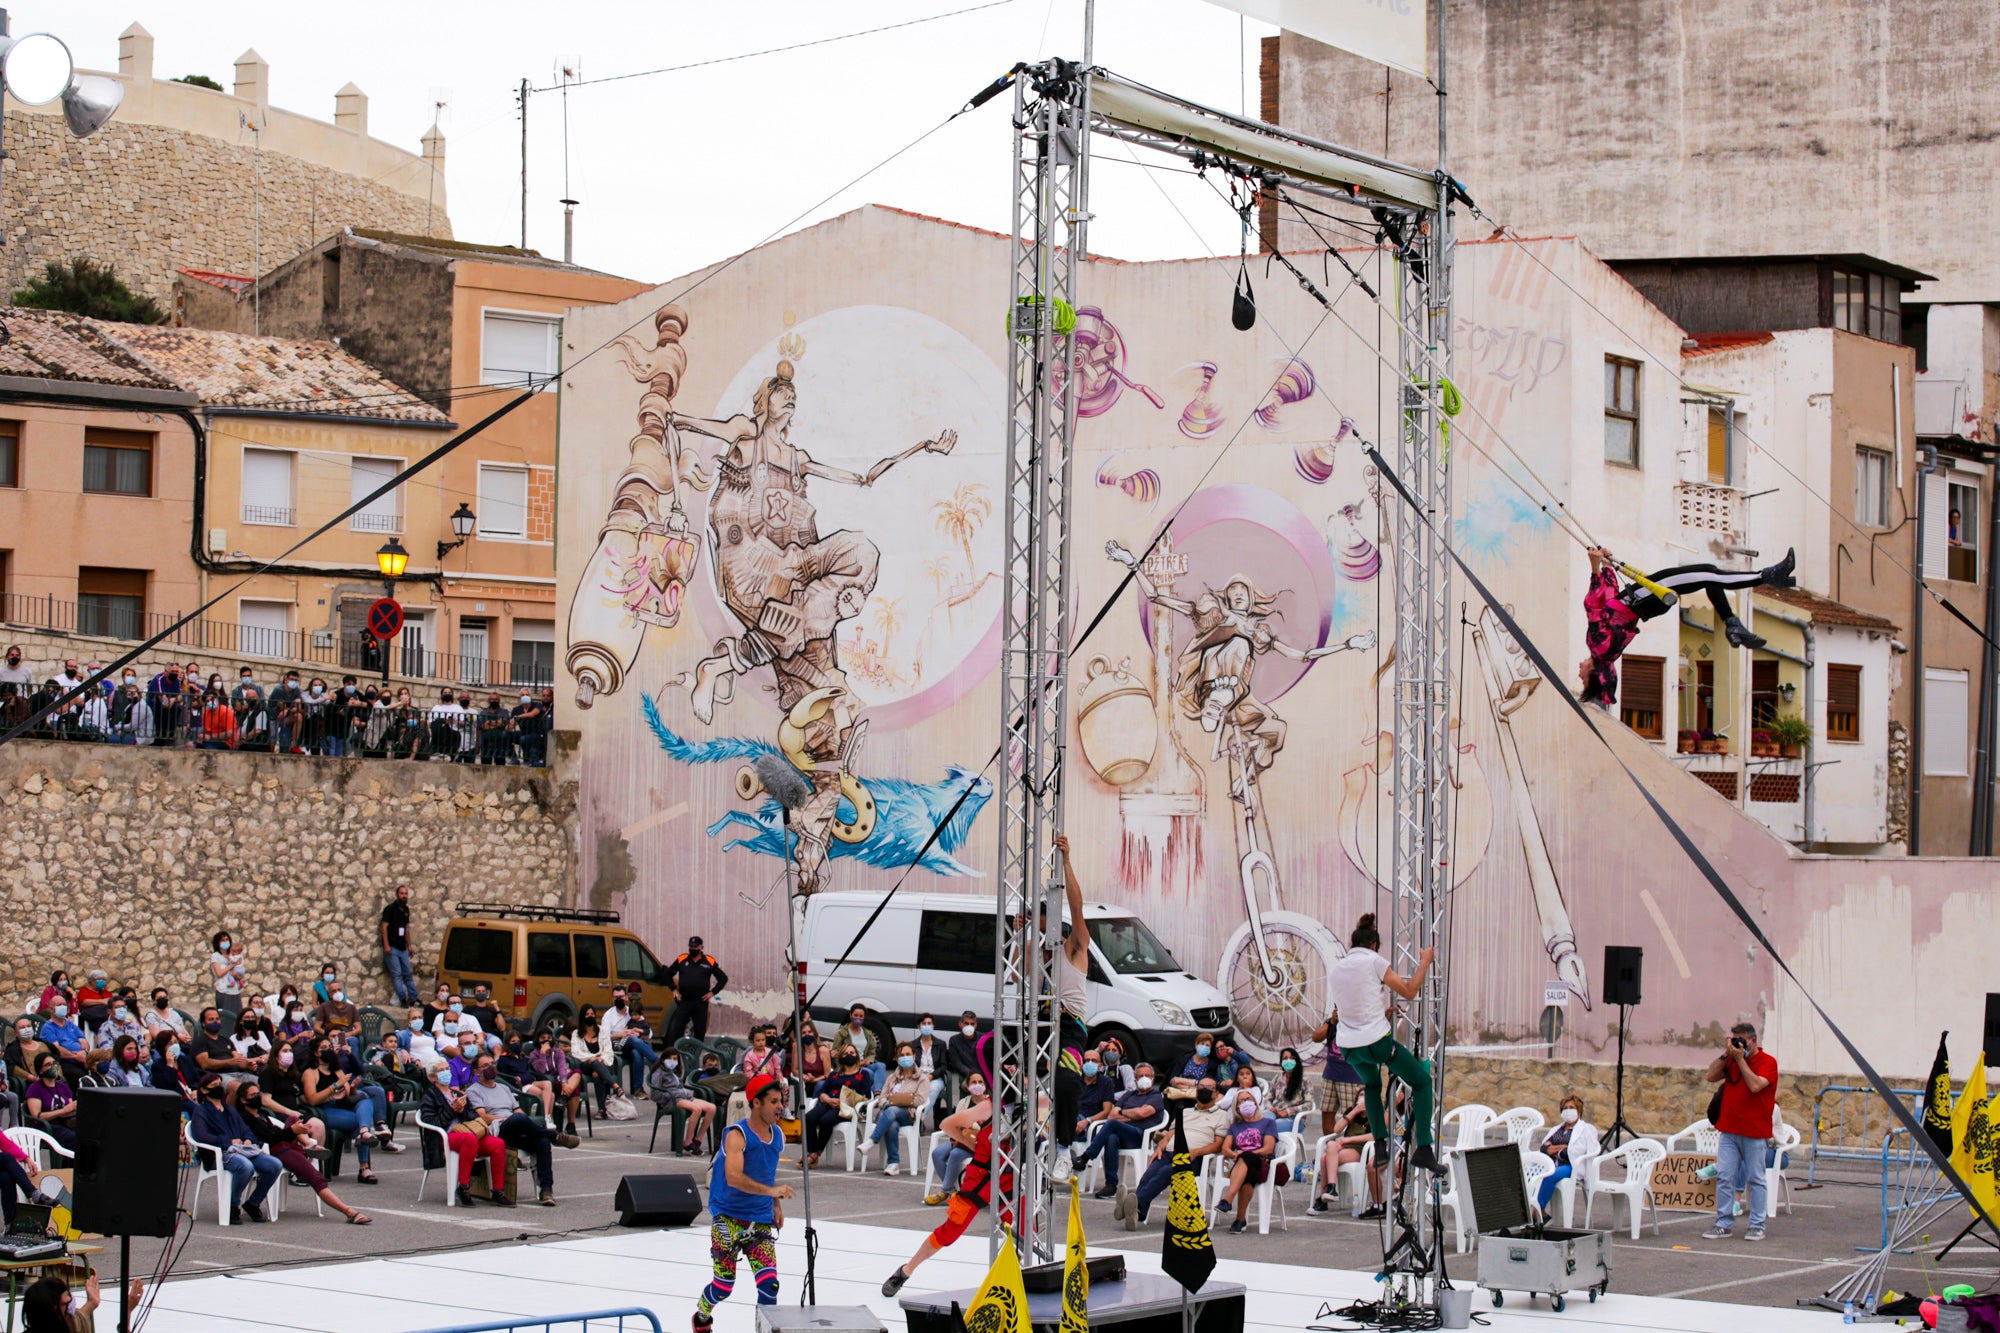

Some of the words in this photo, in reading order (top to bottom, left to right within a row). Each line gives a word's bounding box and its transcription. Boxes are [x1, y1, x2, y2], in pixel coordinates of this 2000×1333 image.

[1147, 553, 1185, 573] PETRER
[1546, 991, 1567, 1000] SALIDA
[1654, 1173, 1678, 1185] CON
[1653, 1191, 1715, 1208] EMAZOS
